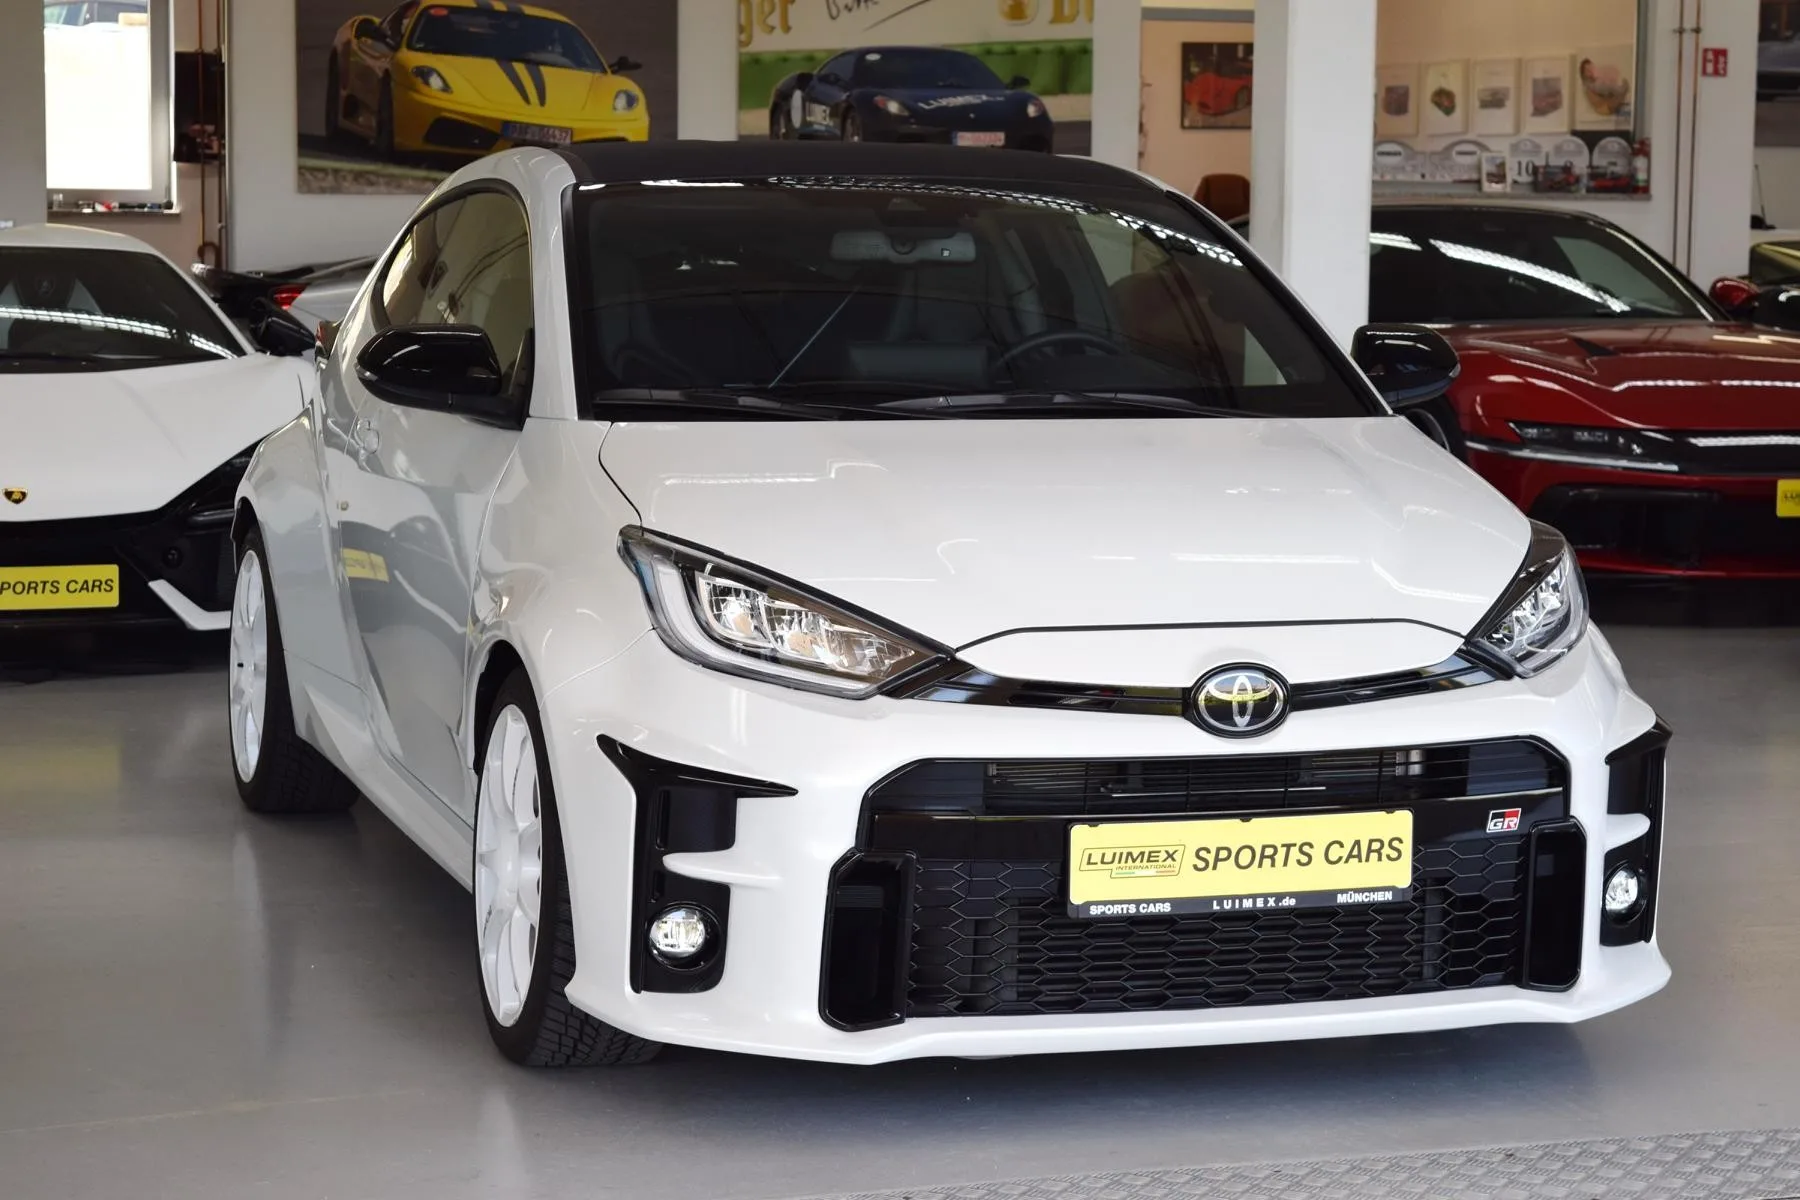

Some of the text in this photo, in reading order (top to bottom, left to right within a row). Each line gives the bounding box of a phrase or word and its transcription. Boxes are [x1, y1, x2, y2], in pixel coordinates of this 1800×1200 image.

[66, 579, 114, 593] CARS
[1489, 816, 1519, 830] GR
[1086, 849, 1179, 866] LUIMEX
[1192, 836, 1404, 872] SPORTS CARS
[1115, 863, 1177, 871] INTERNATIONAL
[1336, 890, 1393, 904] MÜNCHEN
[1089, 902, 1172, 915] SPORTS CARS
